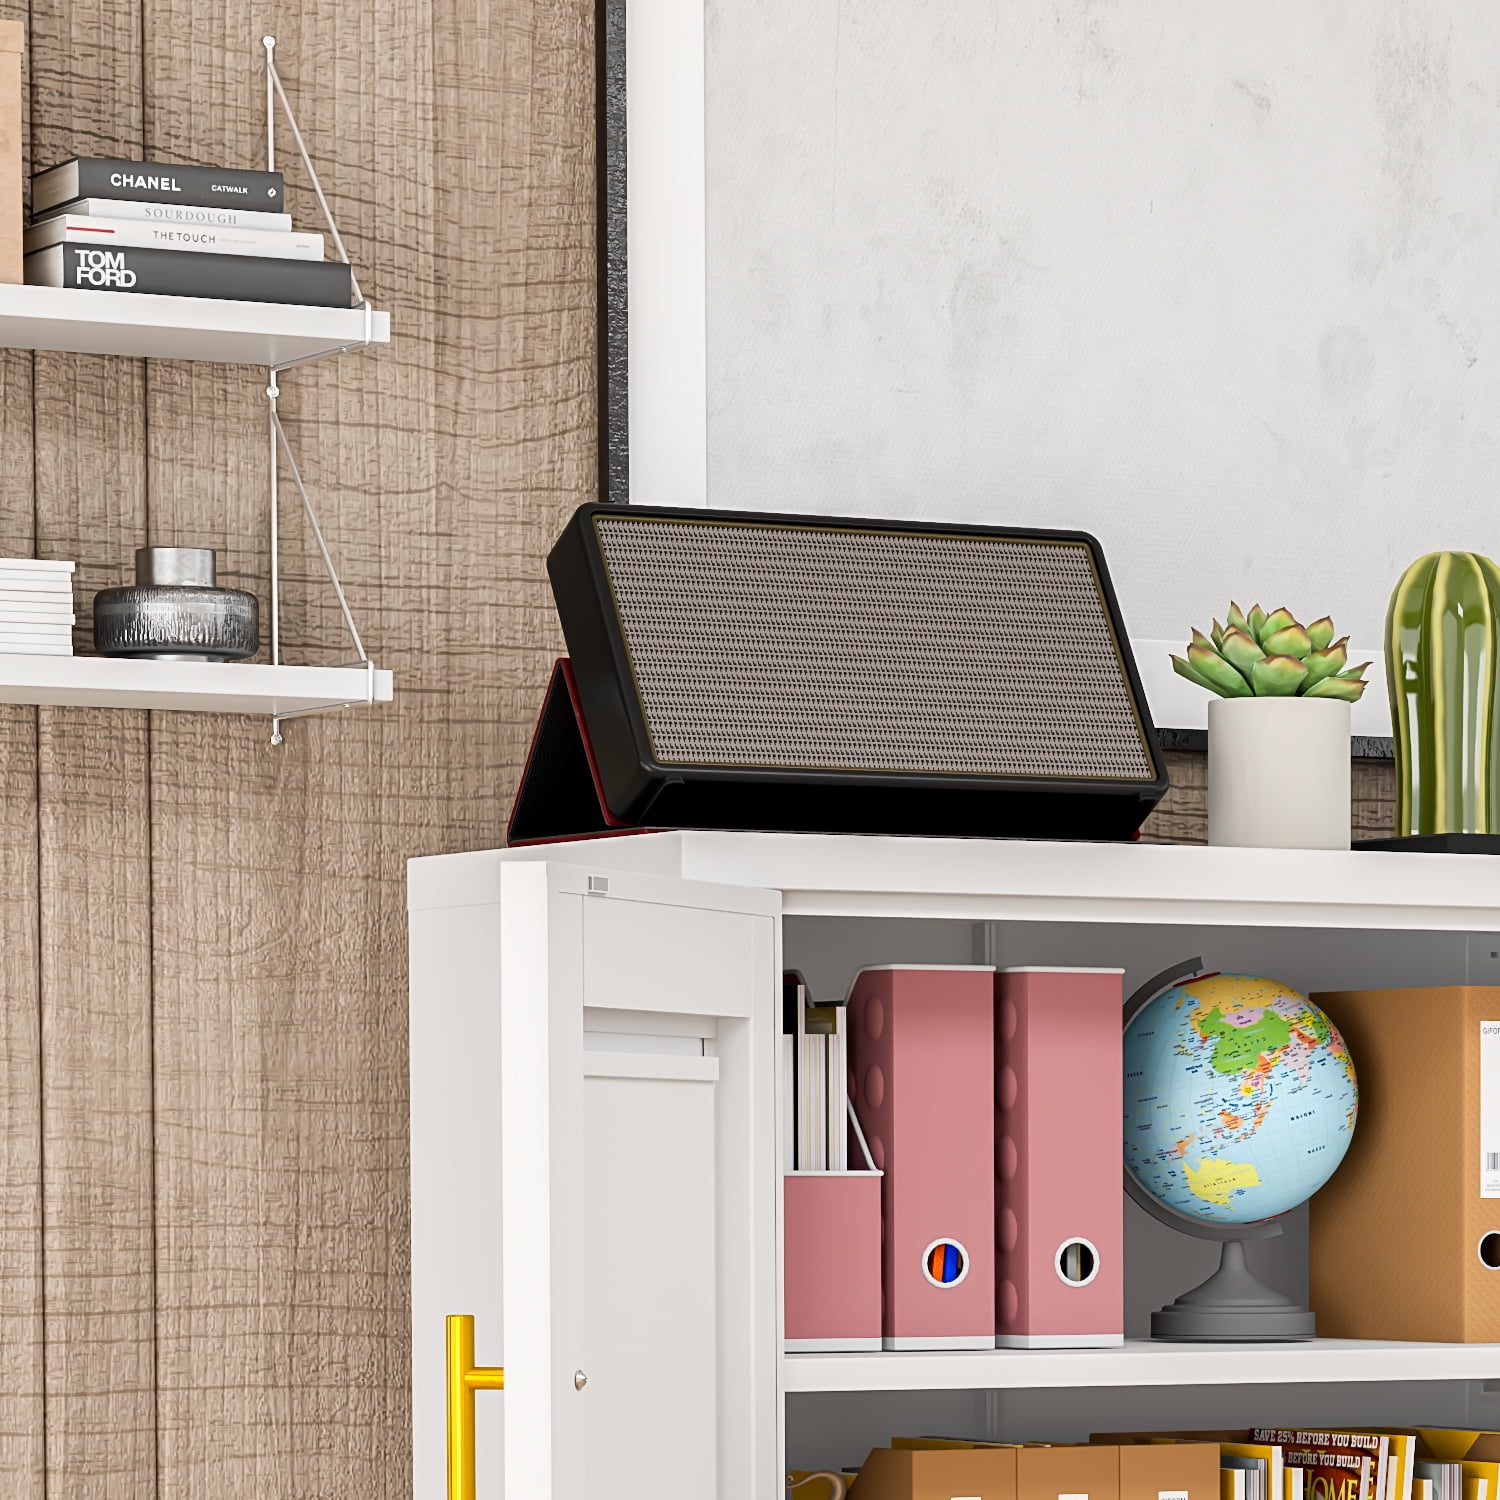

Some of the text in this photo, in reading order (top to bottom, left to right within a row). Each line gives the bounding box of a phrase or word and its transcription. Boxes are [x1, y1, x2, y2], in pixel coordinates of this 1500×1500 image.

[110, 173, 249, 194] CHANEL CATWALK
[144, 207, 237, 224] SOURDOUGH
[153, 230, 174, 241] THE
[176, 232, 216, 244] TOUCH
[74, 249, 126, 270] TOM
[75, 266, 137, 288] FORD
[1253, 1428, 1378, 1449] SAVE 25% BEFORE YOU BUILD
[1288, 1451, 1360, 1468] BEFORE YOU BUILD
